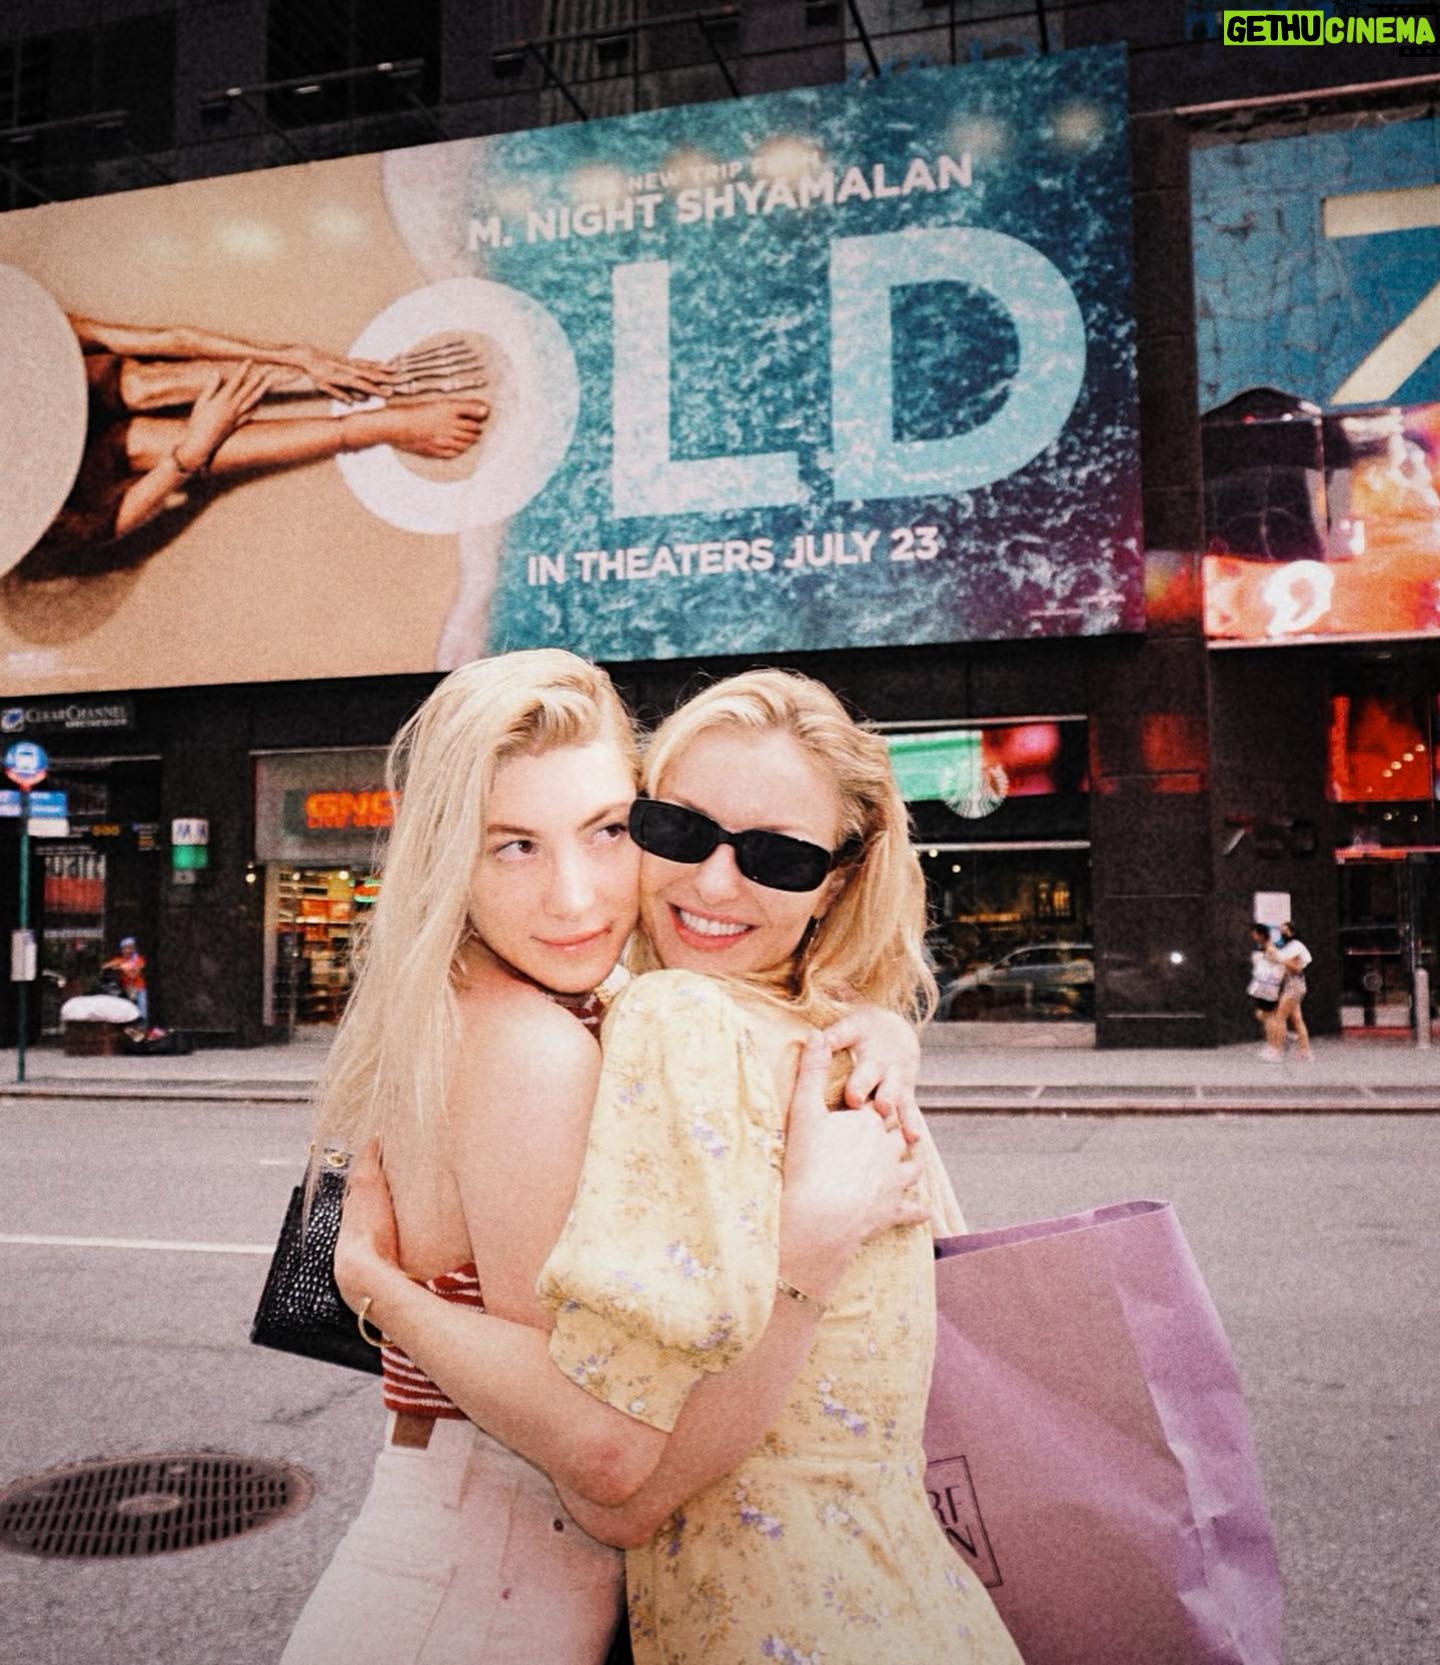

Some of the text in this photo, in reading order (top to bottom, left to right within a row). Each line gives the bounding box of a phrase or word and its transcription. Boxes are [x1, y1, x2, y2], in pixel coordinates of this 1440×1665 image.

[468, 152, 974, 251] M. NIGHT SHYAMALAN
[628, 168, 682, 193] NEW
[689, 160, 743, 185] TRIP
[527, 525, 939, 587] IN THEATERS JULY 23
